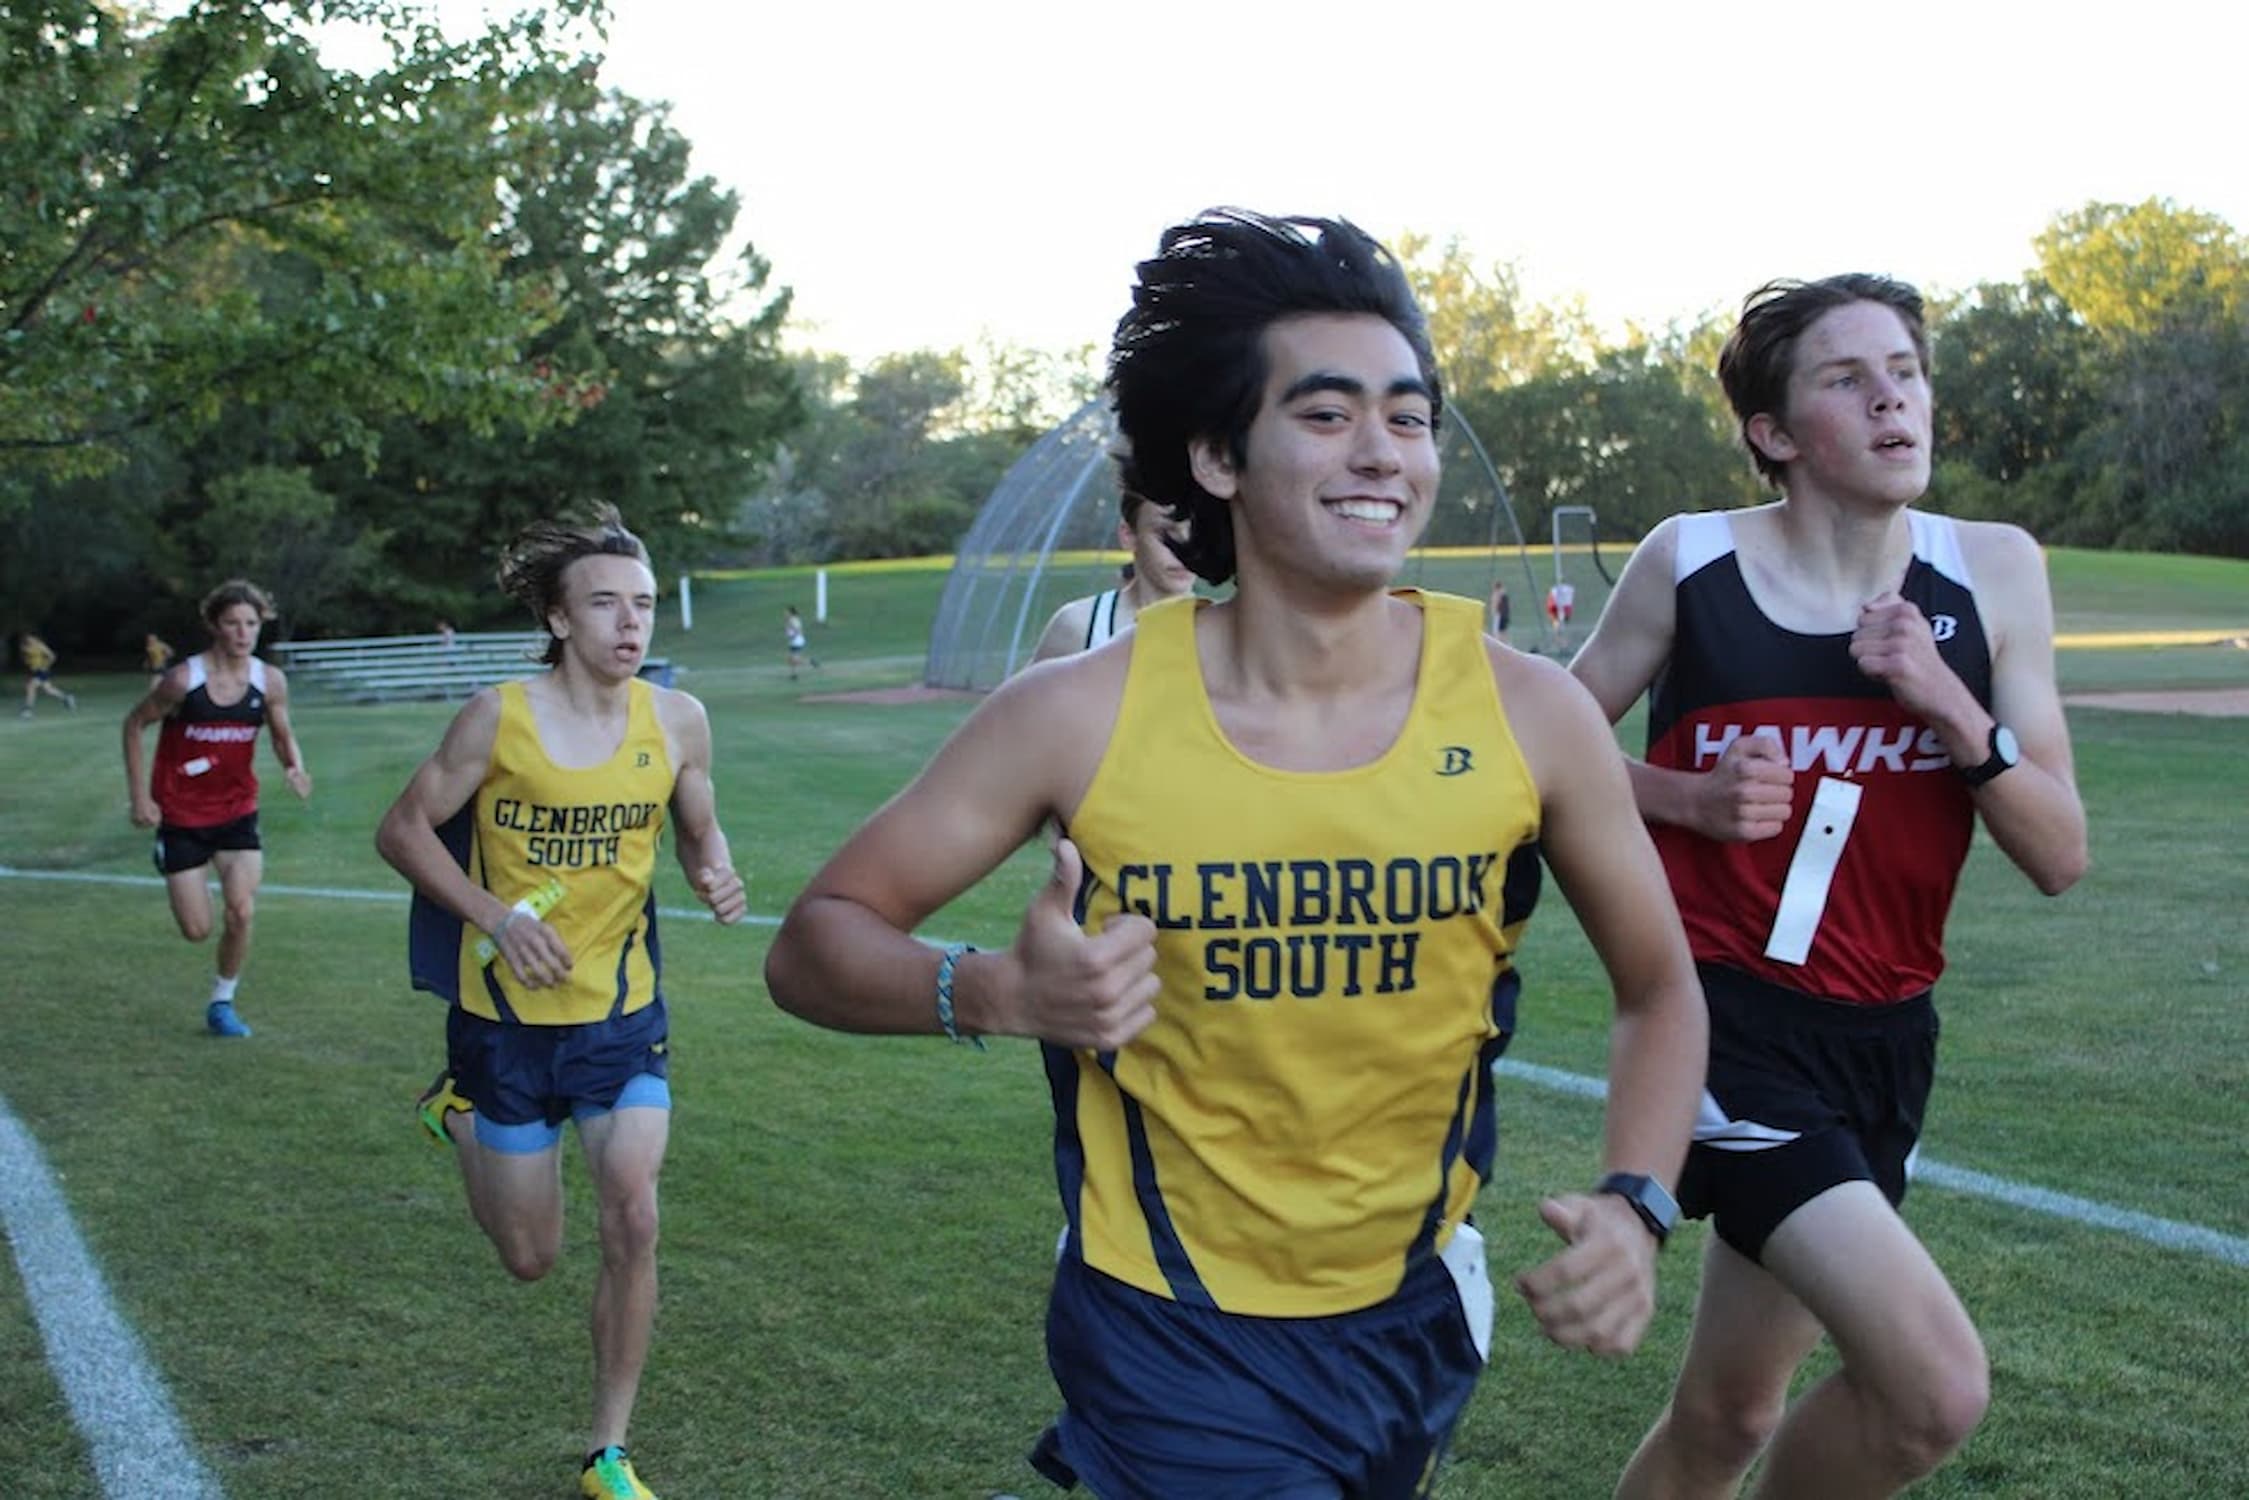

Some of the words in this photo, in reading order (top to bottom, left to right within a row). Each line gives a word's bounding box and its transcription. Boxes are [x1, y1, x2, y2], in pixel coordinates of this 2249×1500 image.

[494, 799, 658, 836] GLENBROOK
[527, 837, 620, 866] SOUTH
[1117, 852, 1496, 930] GLENBROOK
[1204, 932, 1420, 1000] SOUTH
